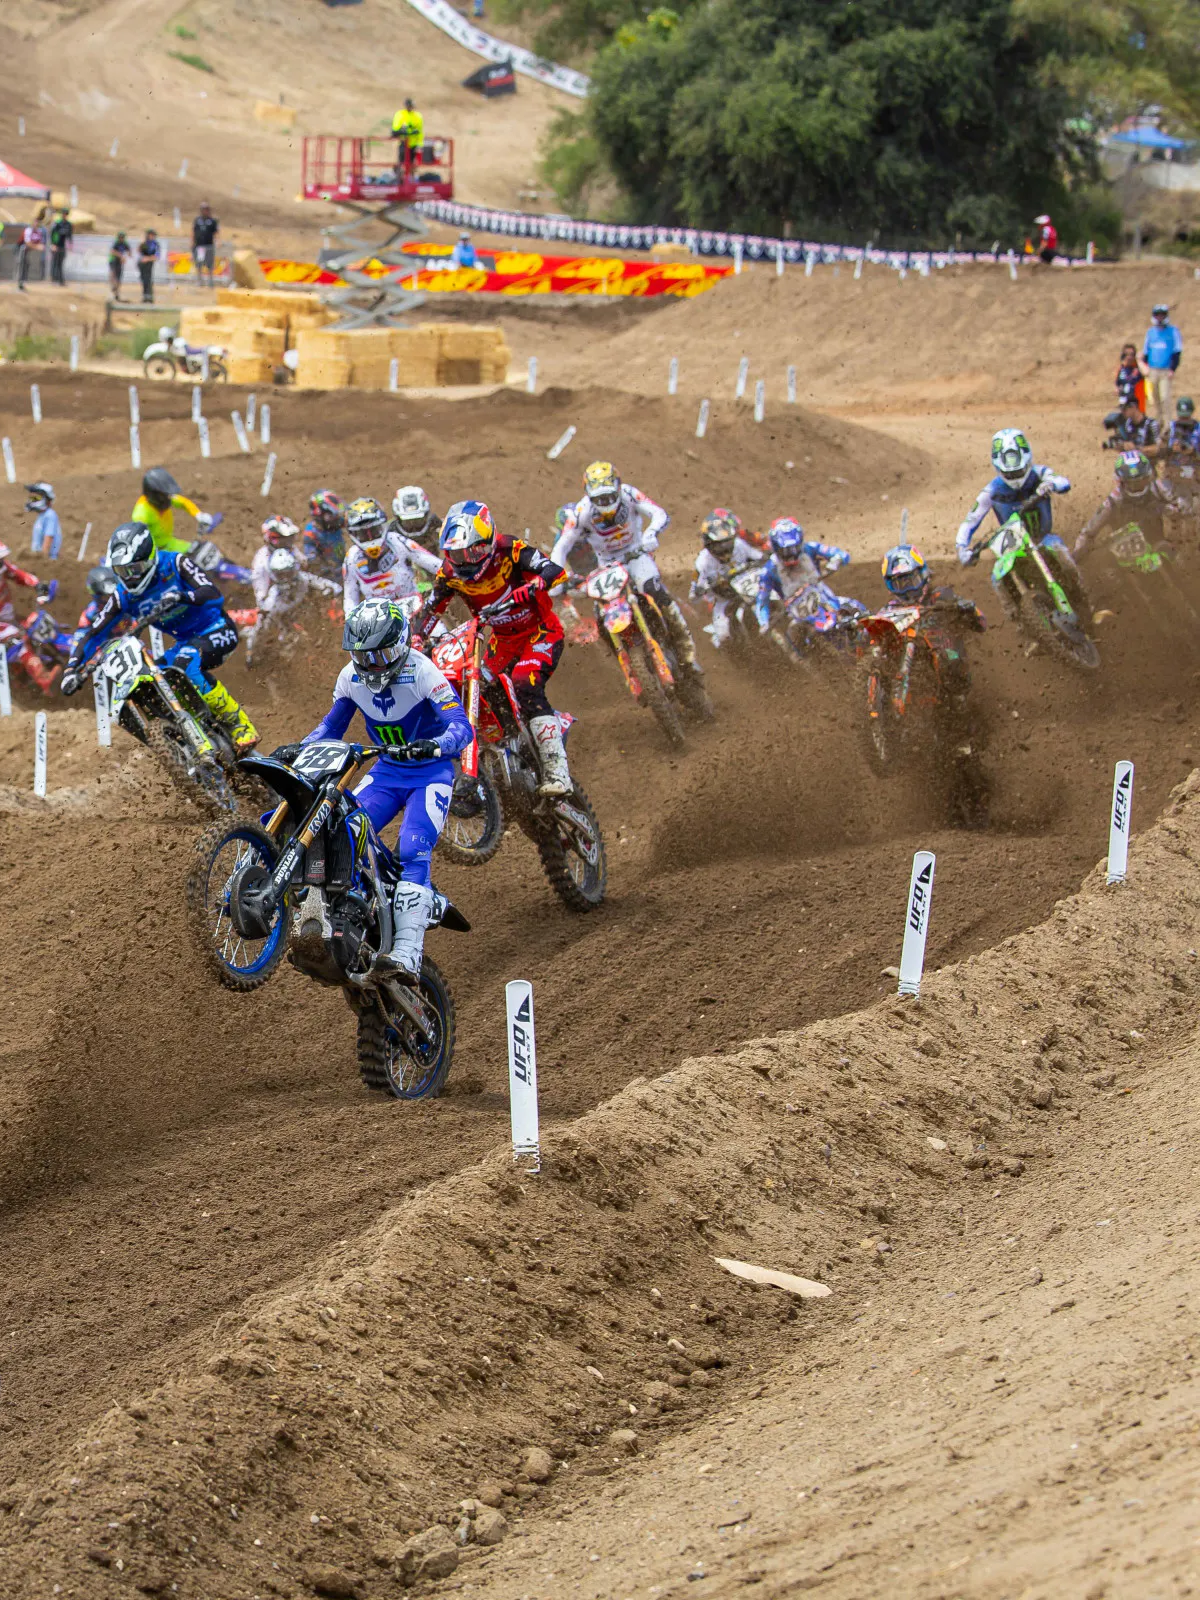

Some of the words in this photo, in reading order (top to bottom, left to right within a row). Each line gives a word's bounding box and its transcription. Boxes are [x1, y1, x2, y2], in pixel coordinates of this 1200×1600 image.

[109, 645, 139, 680] 31
[299, 750, 341, 769] 38
[307, 801, 332, 837] KYB
[1113, 788, 1125, 831] UFO
[274, 848, 297, 886] DUNLOP
[909, 883, 924, 932] UFO
[512, 1023, 527, 1083] UFO
